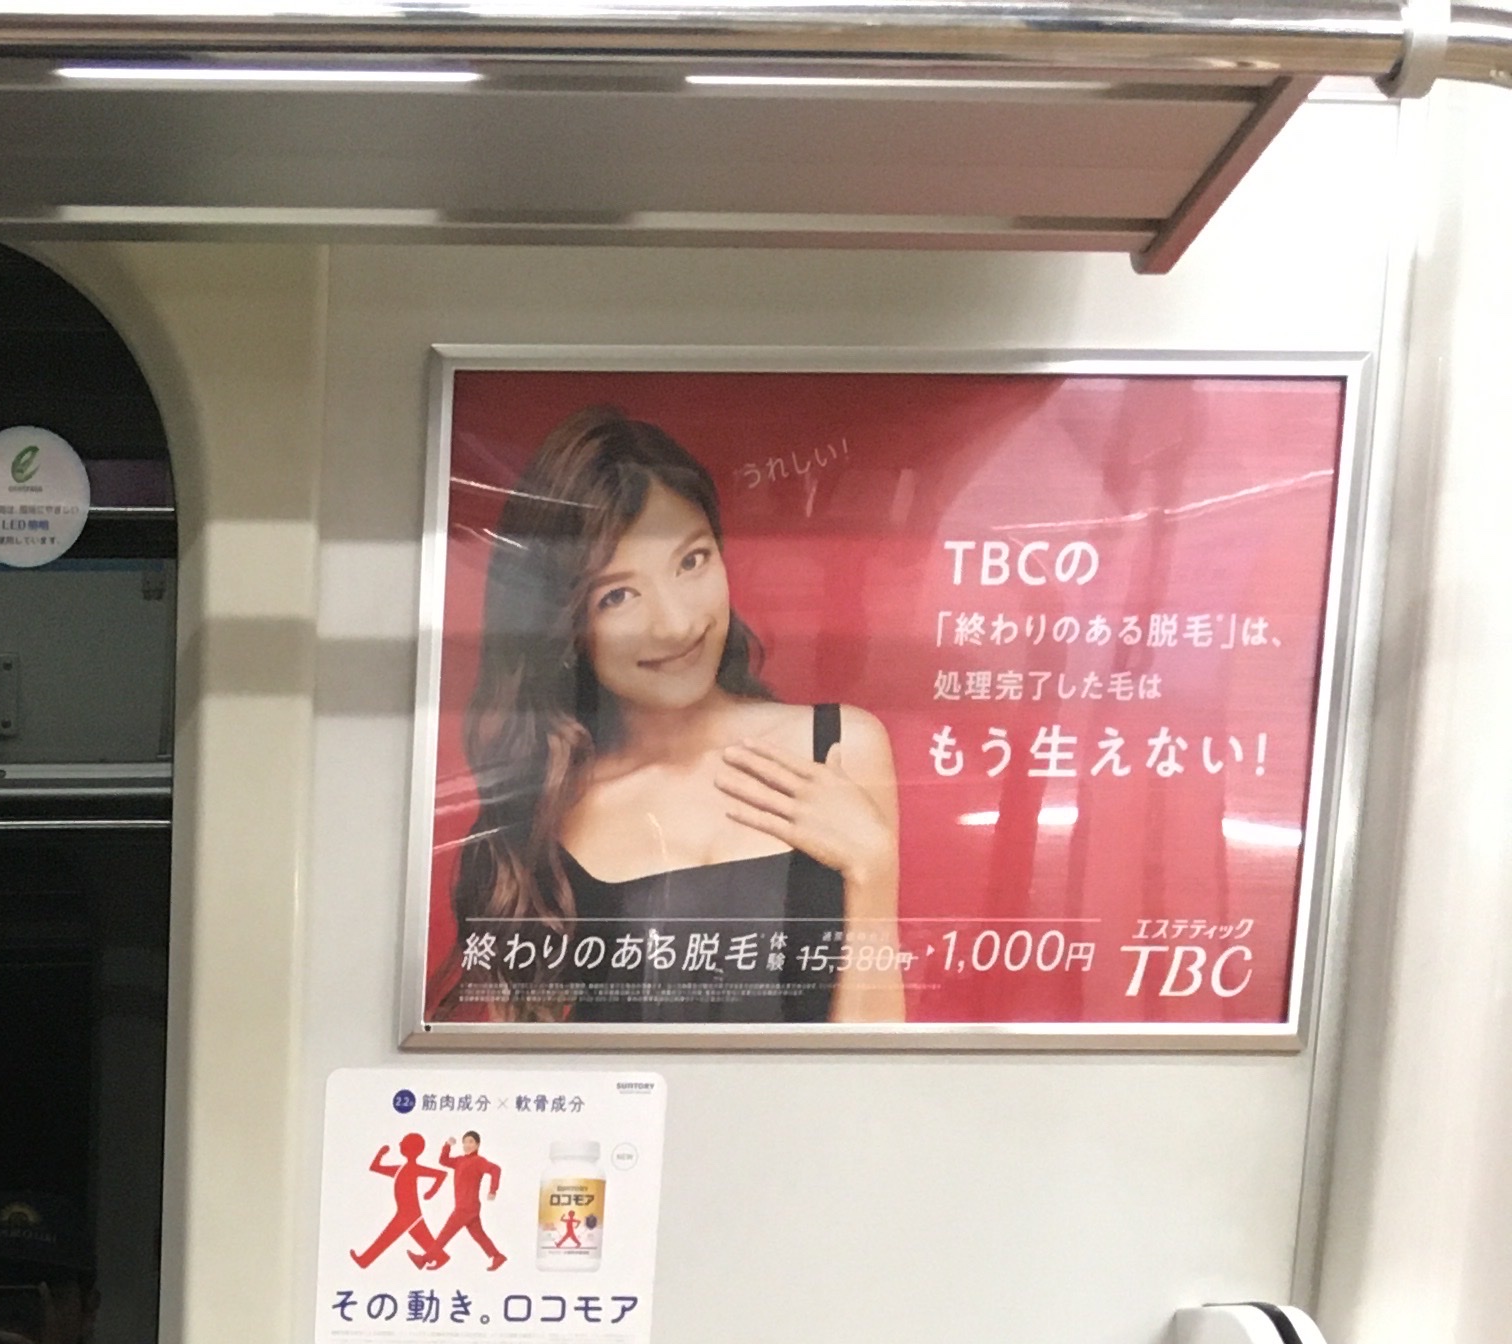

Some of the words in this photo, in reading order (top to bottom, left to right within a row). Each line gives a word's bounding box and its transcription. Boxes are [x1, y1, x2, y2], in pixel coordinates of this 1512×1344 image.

[944, 541, 1099, 586] TBCの
[933, 670, 1162, 701] 処理完了した毛は
[929, 725, 1267, 778] もう生えない!
[1131, 918, 1254, 940] エステティック
[941, 930, 1095, 973] 1,000円
[1120, 945, 1253, 998] TBC
[421, 1094, 491, 1112] 筋肉成分
[515, 1095, 585, 1113] 軟骨成分
[549, 1194, 595, 1206] ロコモア
[331, 1289, 638, 1325] その動き。ロコモア
